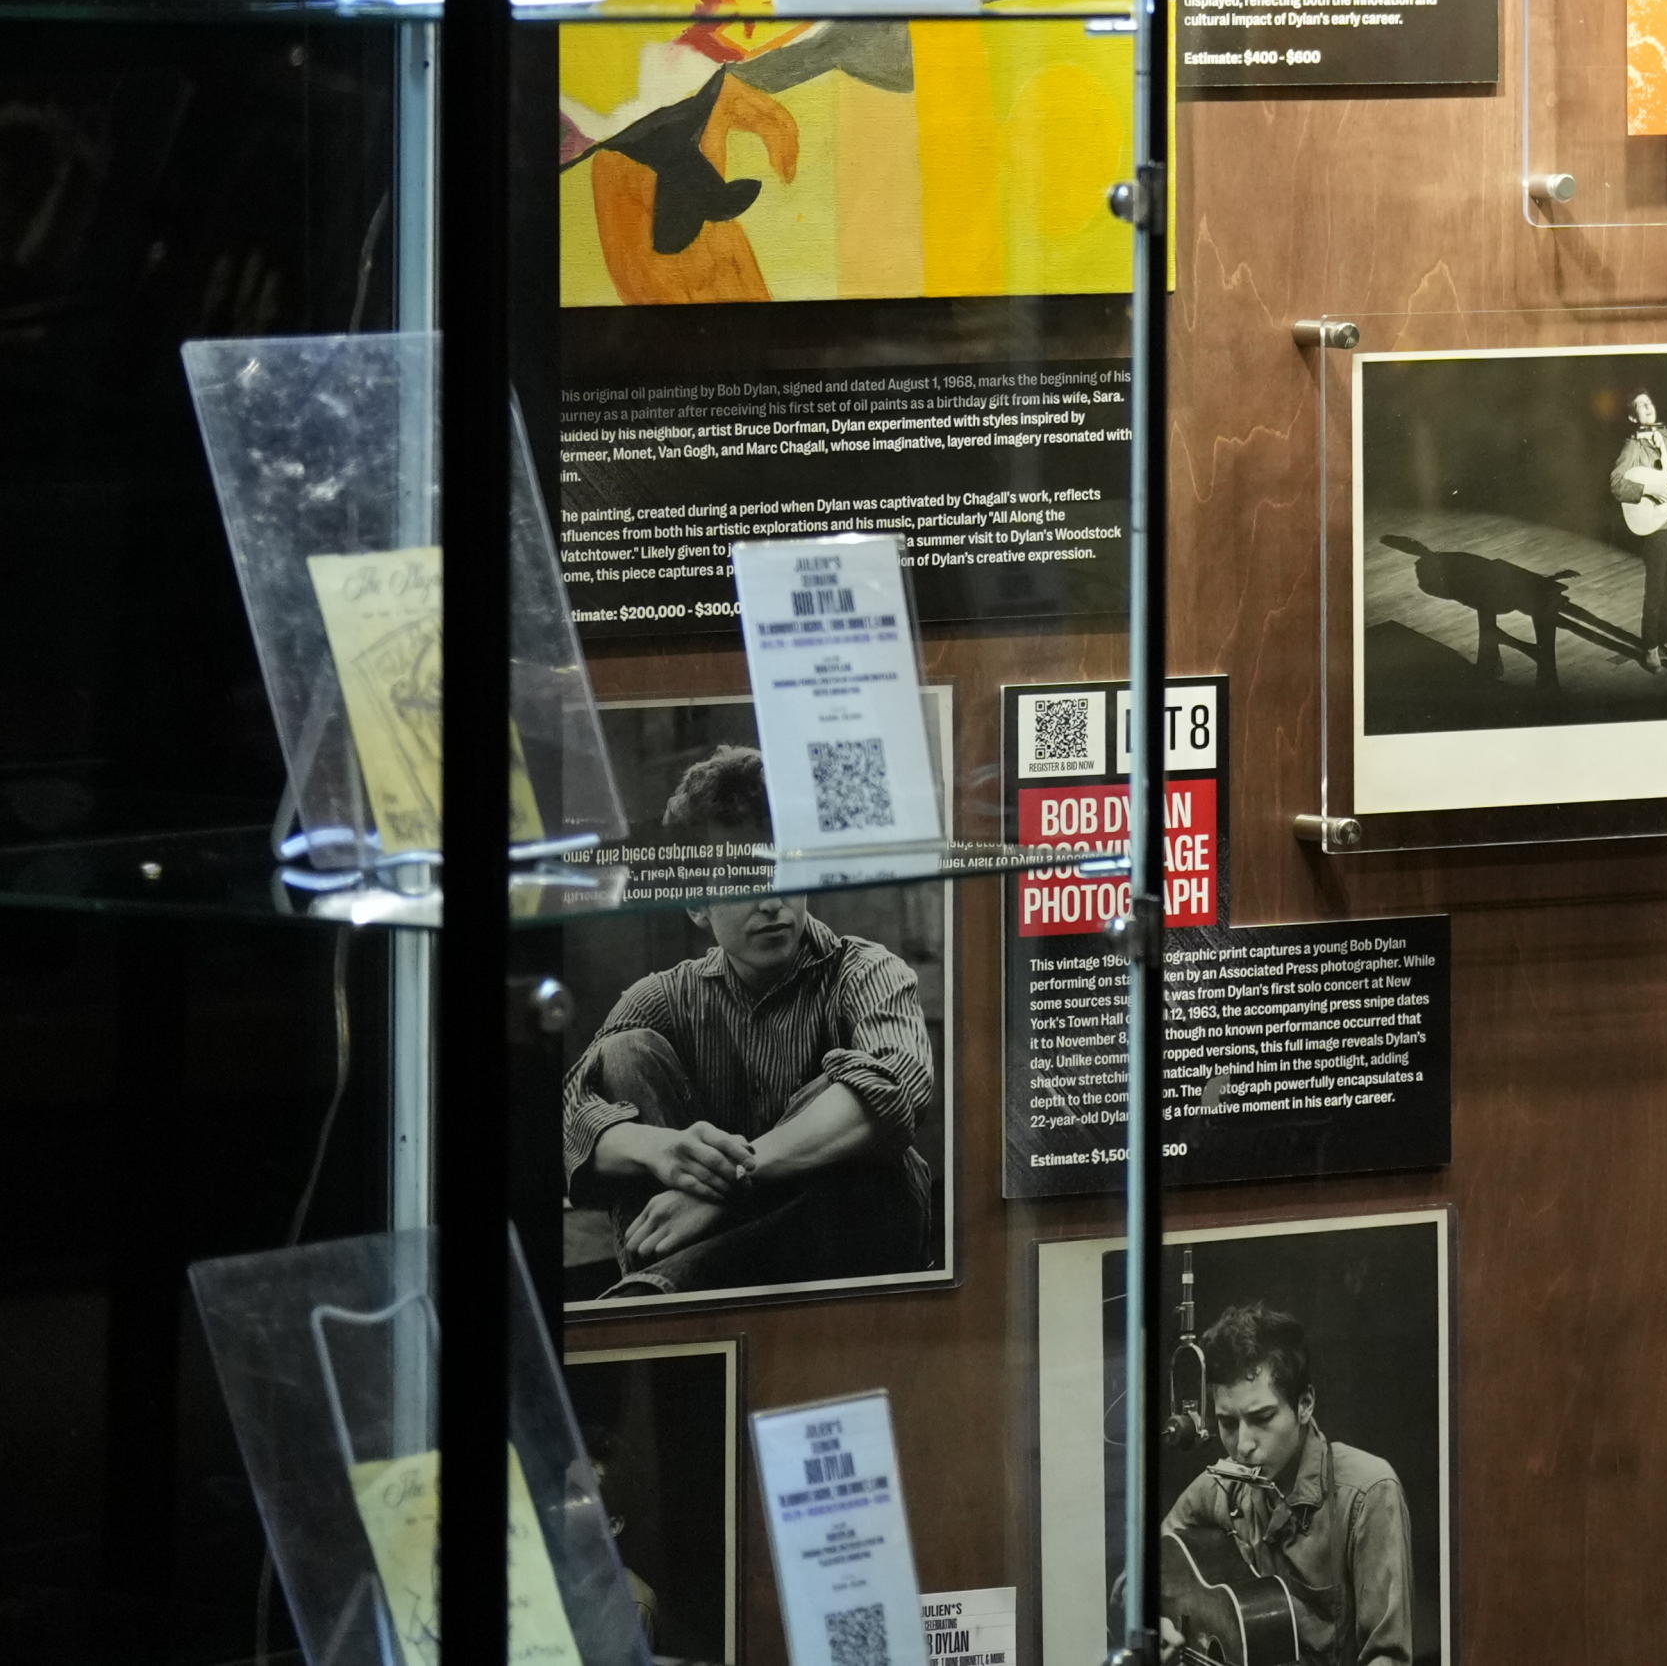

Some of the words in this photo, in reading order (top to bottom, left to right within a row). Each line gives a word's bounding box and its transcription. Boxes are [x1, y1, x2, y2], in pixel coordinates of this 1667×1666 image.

[1184, 52, 1242, 64] Estimate:
[1243, 50, 1278, 65] $400
[1285, 50, 1321, 64] $600
[560, 450, 610, 462] ermeer,
[612, 447, 656, 460] Monet,
[657, 445, 681, 458] Van
[683, 444, 718, 459] Gogh,
[720, 442, 743, 456] and
[746, 442, 777, 454] Marc
[779, 439, 828, 455] Chagall,
[829, 439, 870, 451] whose
[872, 436, 945, 451] imaginative,
[947, 433, 991, 449] layered
[993, 432, 1041, 447] imagery
[1043, 429, 1104, 443] resonated
[1105, 428, 1132, 440] with
[580, 507, 634, 523] painting,
[636, 505, 685, 519] created
[687, 503, 727, 518] during
[729, 504, 737, 515] a
[739, 501, 778, 516] period
[780, 500, 814, 512] when
[816, 498, 850, 513] Dylan
[852, 499, 877, 509] was
[879, 494, 944, 510] captivated
[946, 493, 961, 508] by
[962, 491, 1016, 506] Chagall's
[1018, 489, 1052, 503] work,
[1053, 488, 1100, 501] reflects
[619, 604, 685, 620] $200,000
[694, 602, 741, 617] $300,0
[1190, 704, 1210, 750] 8
[1029, 762, 1059, 772] REGISTER
[1060, 761, 1066, 771] &
[1067, 761, 1078, 771] BID
[1079, 760, 1094, 770] NOW
[1041, 797, 1098, 836] BOB
[1218, 946, 1247, 961] print
[1248, 944, 1302, 958] captures
[1303, 944, 1311, 954] a
[1312, 940, 1348, 956] young
[1349, 939, 1372, 951] Bob
[1374, 938, 1406, 952] Dylan
[1029, 977, 1096, 992] performing
[1097, 976, 1111, 987] on
[1186, 969, 1200, 982] by
[1201, 969, 1216, 979] an
[1218, 964, 1283, 978] Associated
[1285, 963, 1318, 974] Press
[1320, 958, 1401, 973] photographer.
[1402, 954, 1435, 967] While
[1029, 999, 1062, 1010] some
[1064, 996, 1111, 1008] sources
[1171, 989, 1195, 1001] was
[1197, 987, 1225, 999] from
[1227, 984, 1269, 999] Dylan's
[1270, 982, 1295, 994] first
[1297, 980, 1321, 993] solo
[1323, 978, 1369, 991] concert
[1371, 976, 1383, 988] at
[1385, 976, 1411, 987] New
[1030, 1153, 1089, 1166] Estimate:
[935, 1630, 969, 1654] DYLAN
